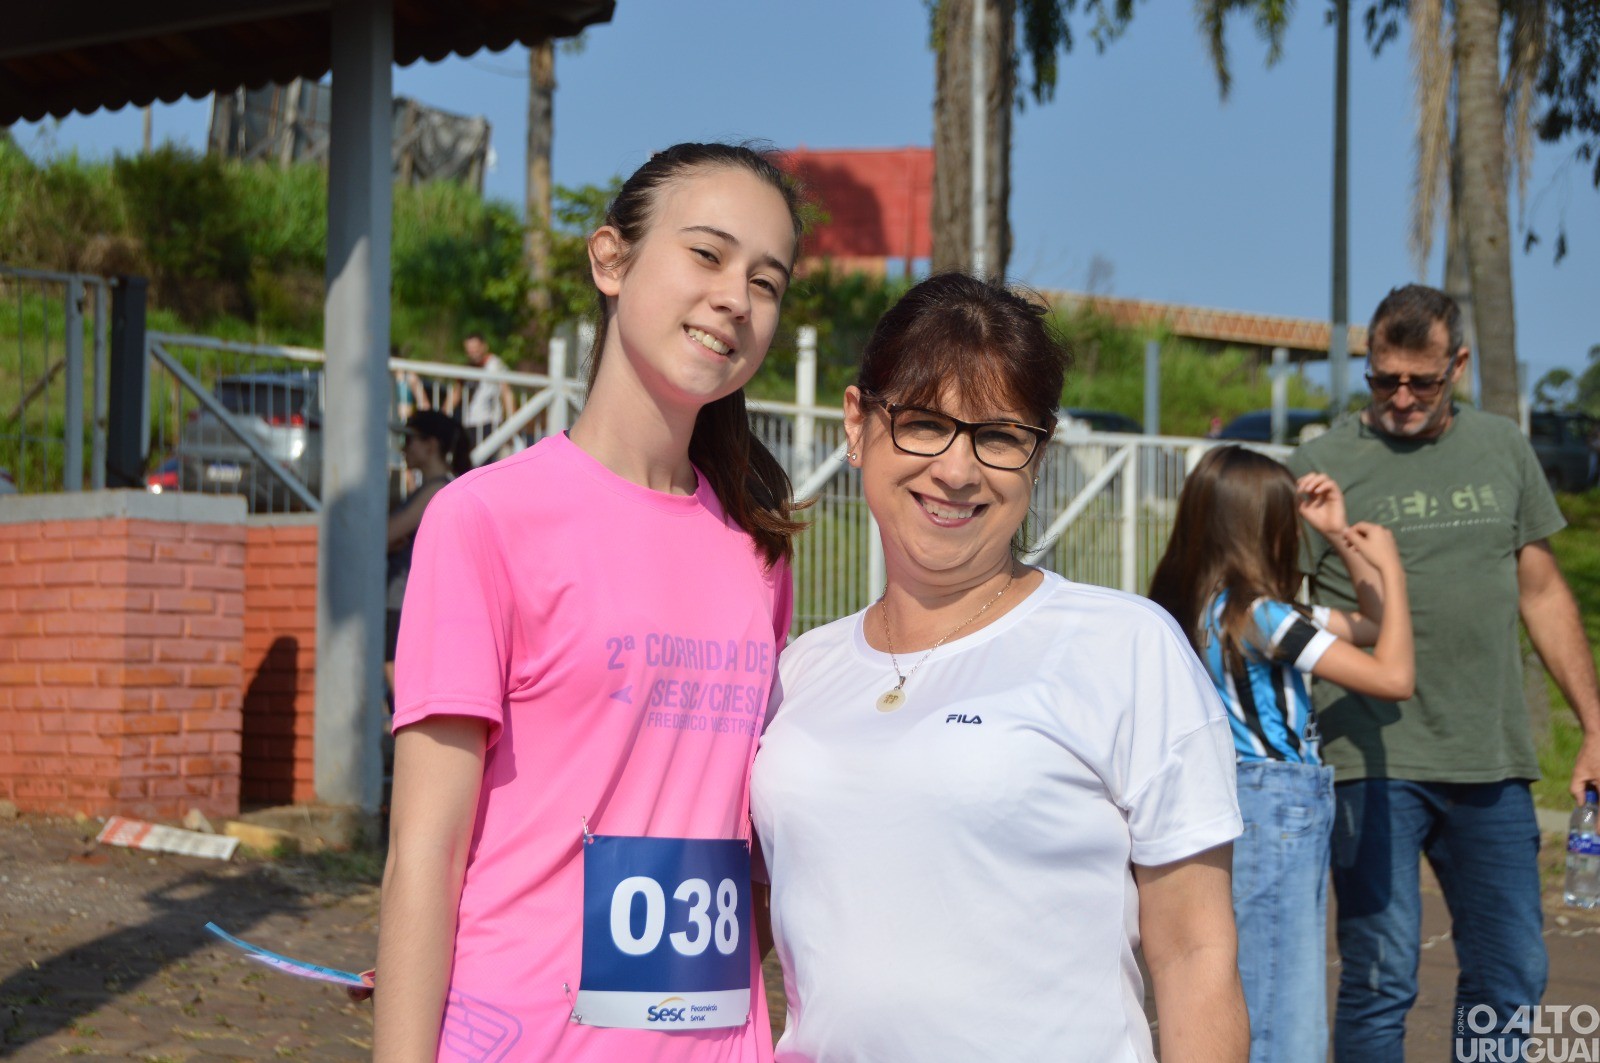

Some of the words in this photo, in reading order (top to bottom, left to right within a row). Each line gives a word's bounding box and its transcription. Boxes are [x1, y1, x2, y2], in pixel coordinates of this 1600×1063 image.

[645, 633, 738, 672] CORRIDA
[744, 640, 769, 675] DE
[945, 714, 983, 724] FILA
[610, 876, 740, 956] 038
[647, 1005, 686, 1022] Sesc
